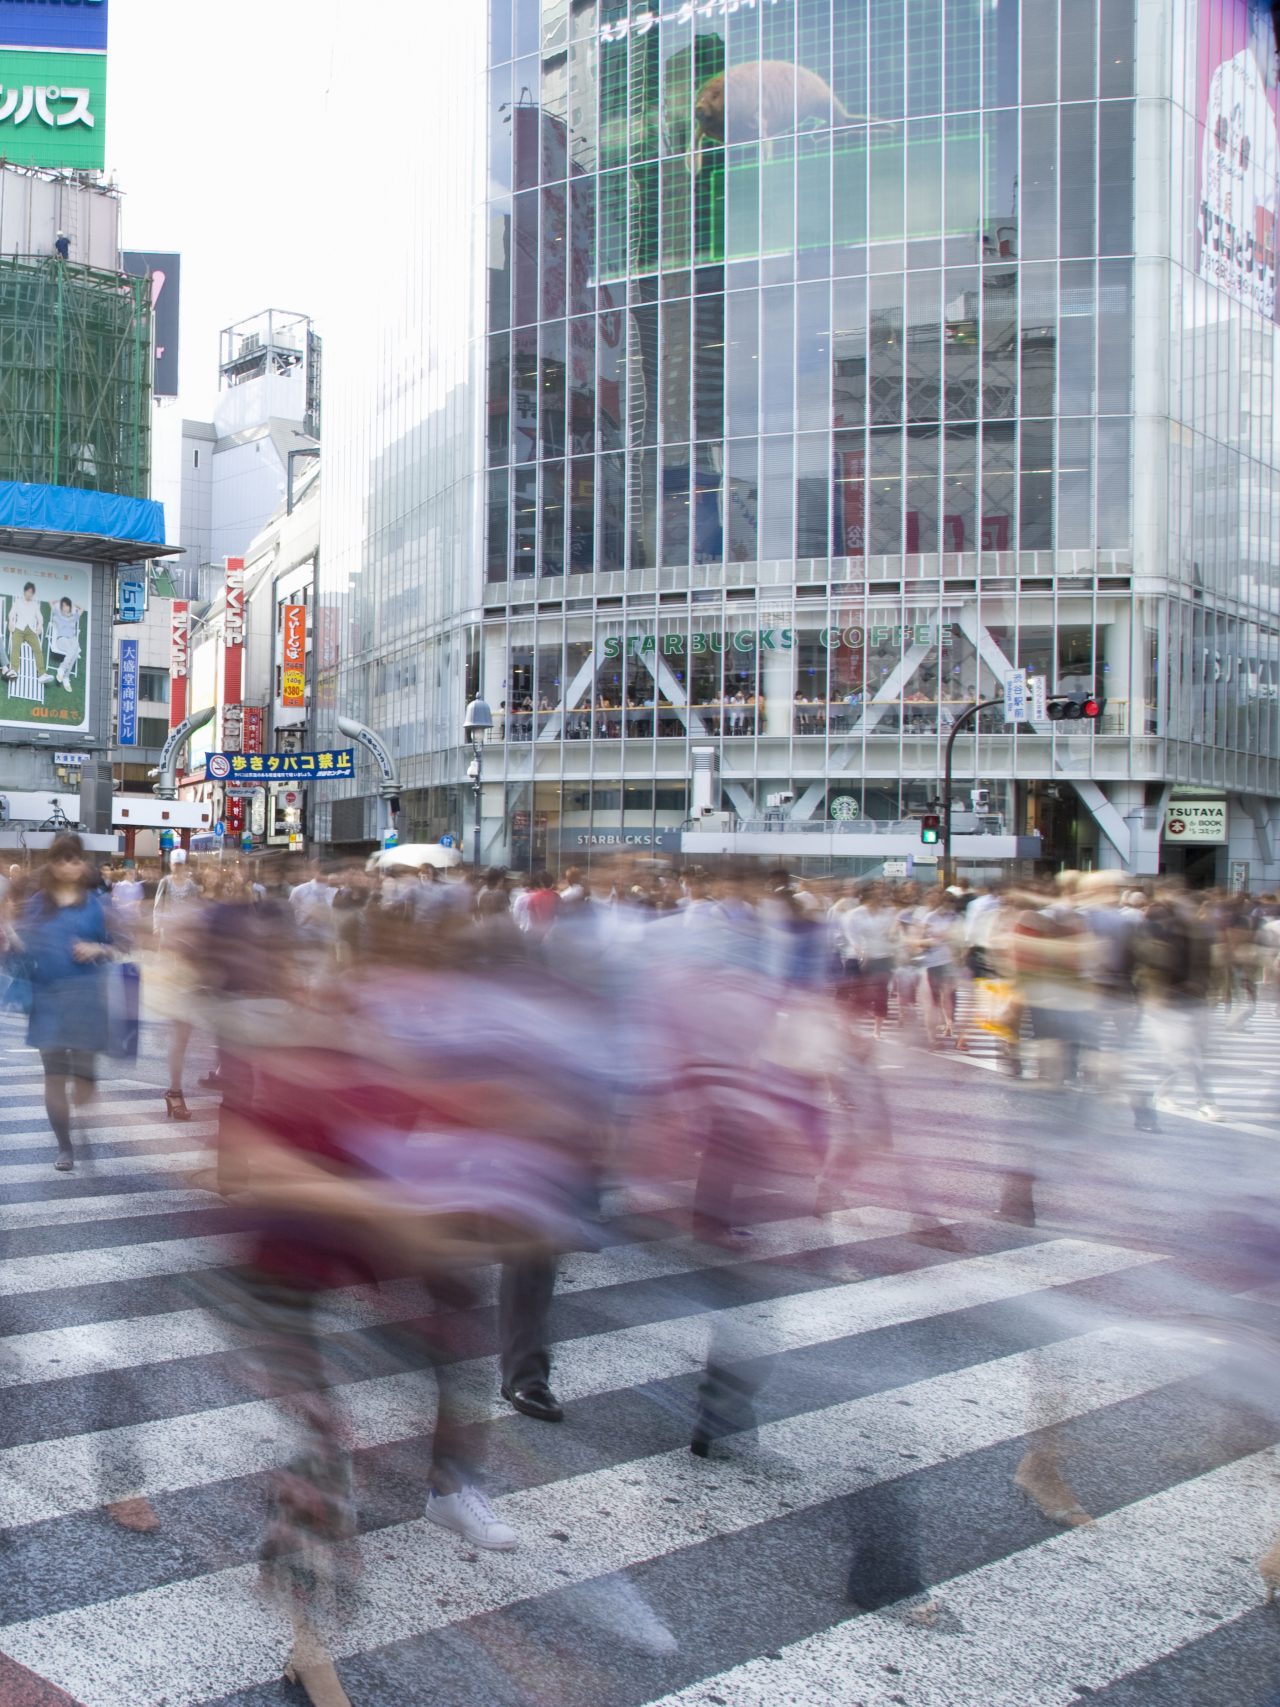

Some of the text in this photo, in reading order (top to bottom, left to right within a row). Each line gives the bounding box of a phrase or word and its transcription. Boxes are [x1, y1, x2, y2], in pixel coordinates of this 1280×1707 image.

[223, 568, 244, 648] さくらや
[168, 610, 188, 680] さくらや
[604, 622, 954, 658] STARBUCKS COFFEE
[122, 646, 136, 739] 大盛堂商事ビル
[231, 752, 352, 772] 歩きタバコ禁止
[1168, 808, 1223, 817] TSUTAYA
